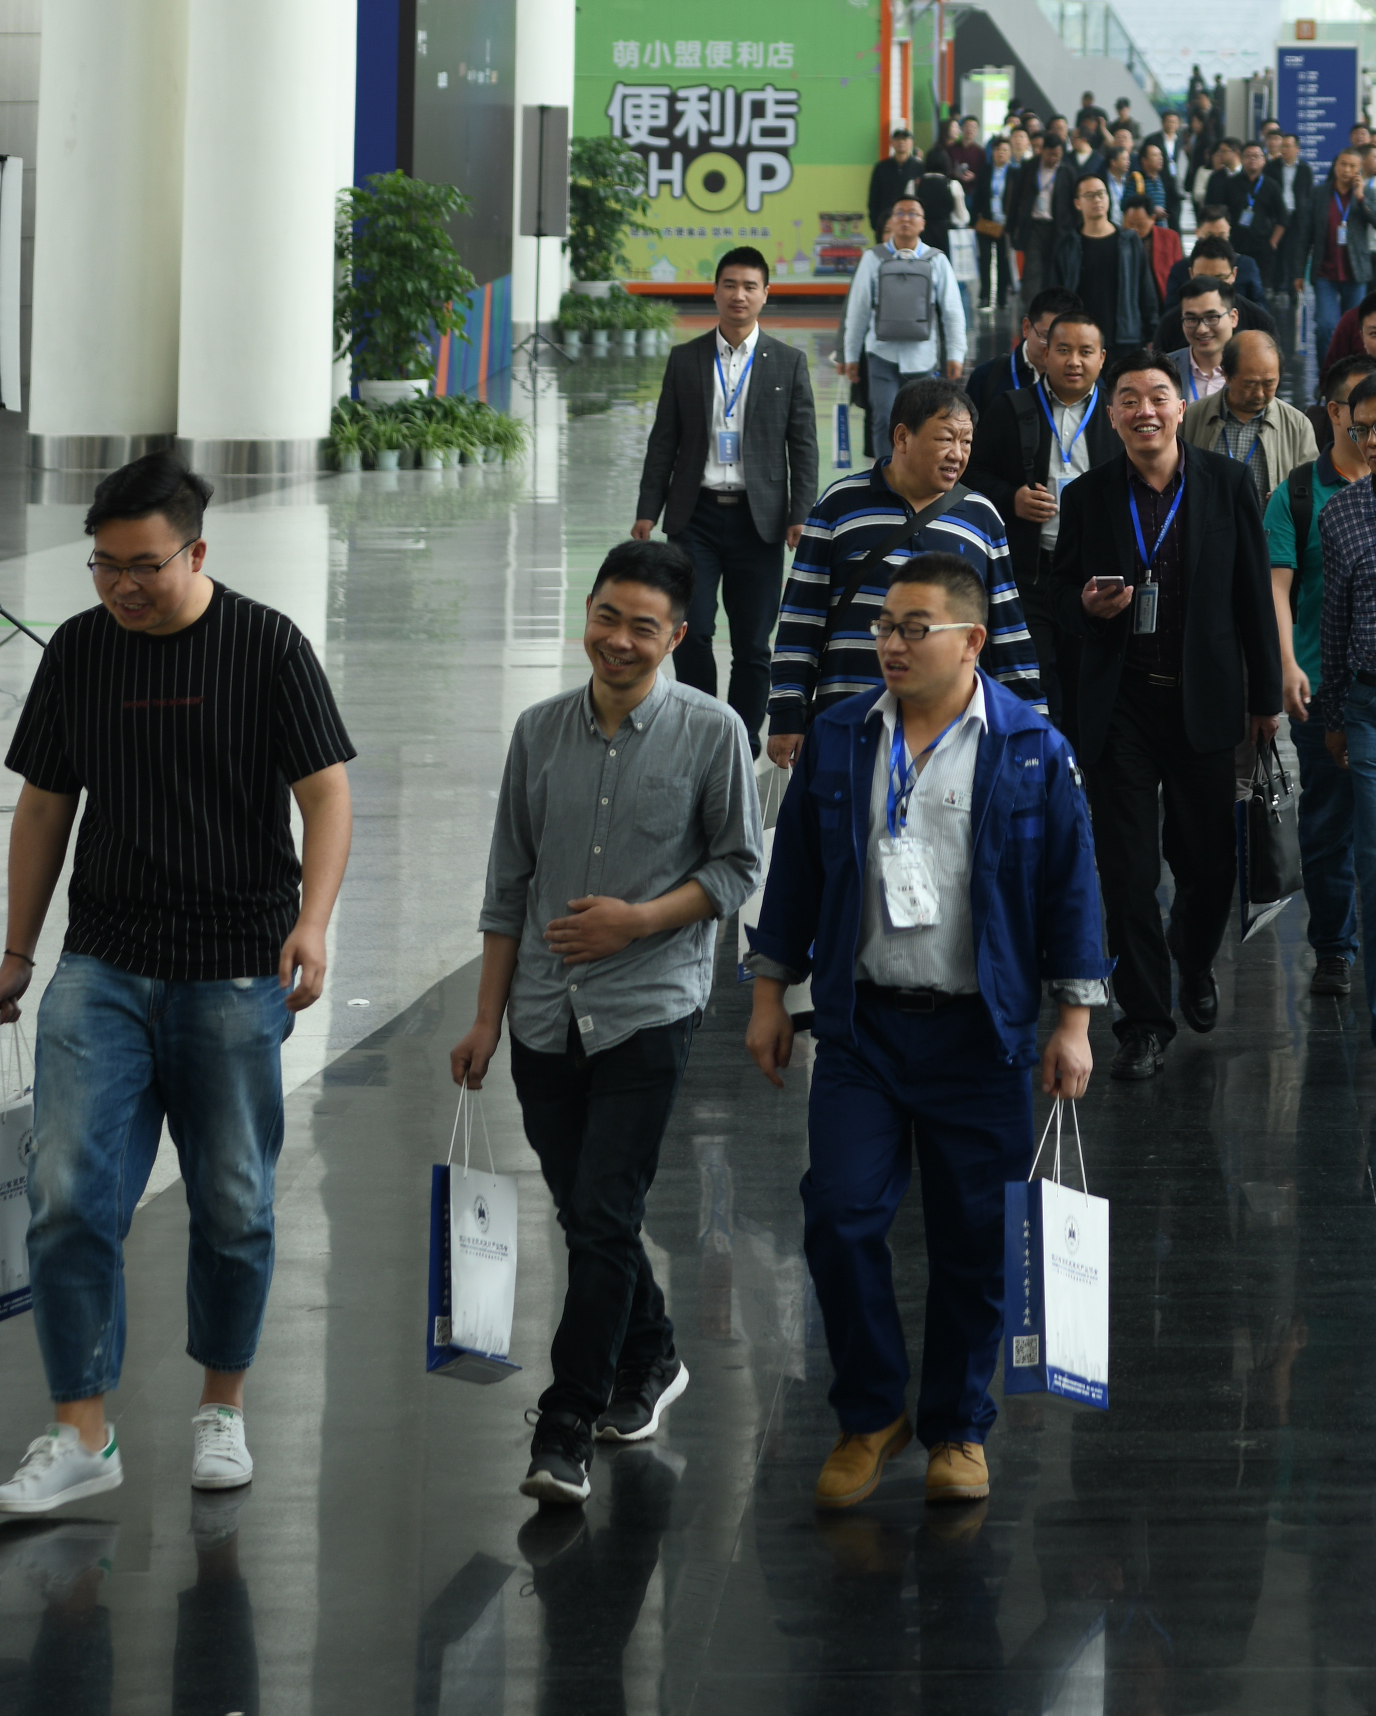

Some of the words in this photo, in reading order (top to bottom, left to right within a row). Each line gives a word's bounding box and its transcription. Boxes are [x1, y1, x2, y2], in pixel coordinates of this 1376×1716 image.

[612, 40, 795, 69] 萌小盟便利店
[606, 82, 801, 148] 便利店
